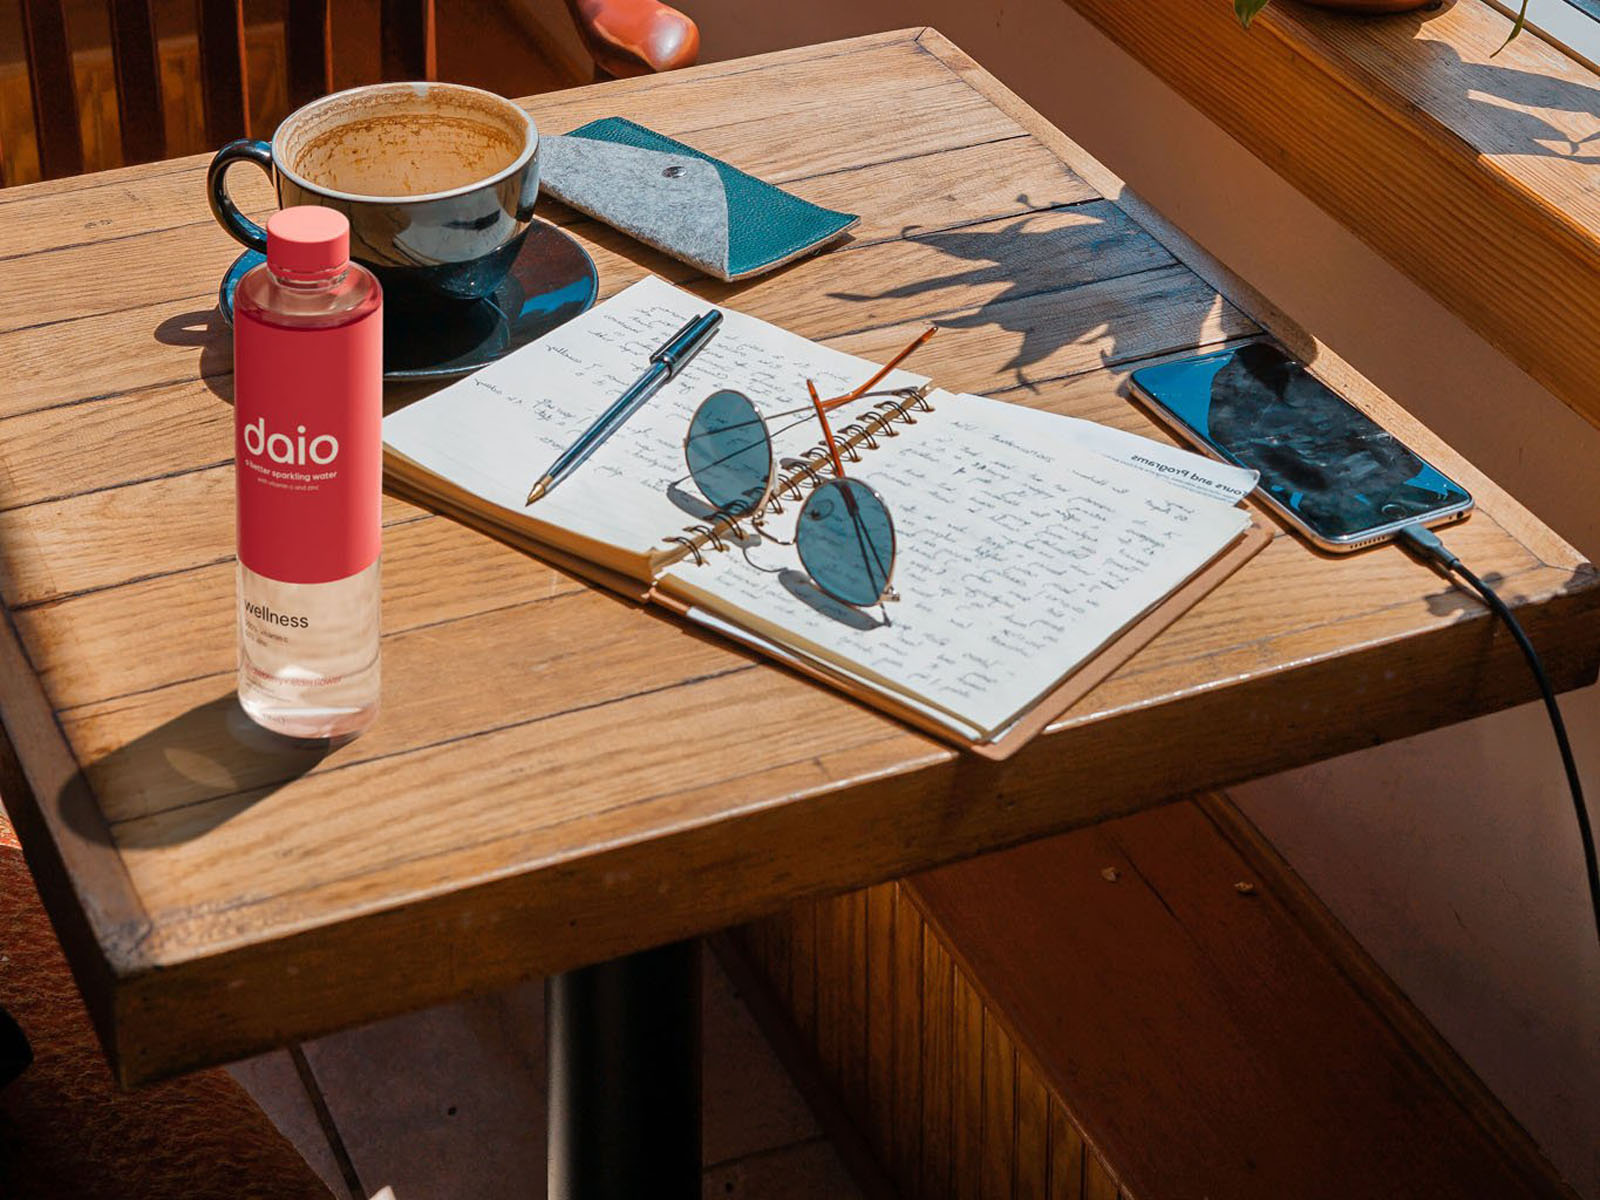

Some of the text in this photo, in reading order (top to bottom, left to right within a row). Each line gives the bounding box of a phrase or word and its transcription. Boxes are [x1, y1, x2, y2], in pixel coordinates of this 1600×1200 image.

[244, 417, 339, 465] daio
[272, 470, 312, 482] sparkling
[312, 471, 338, 481] water
[244, 600, 309, 629] wellness
